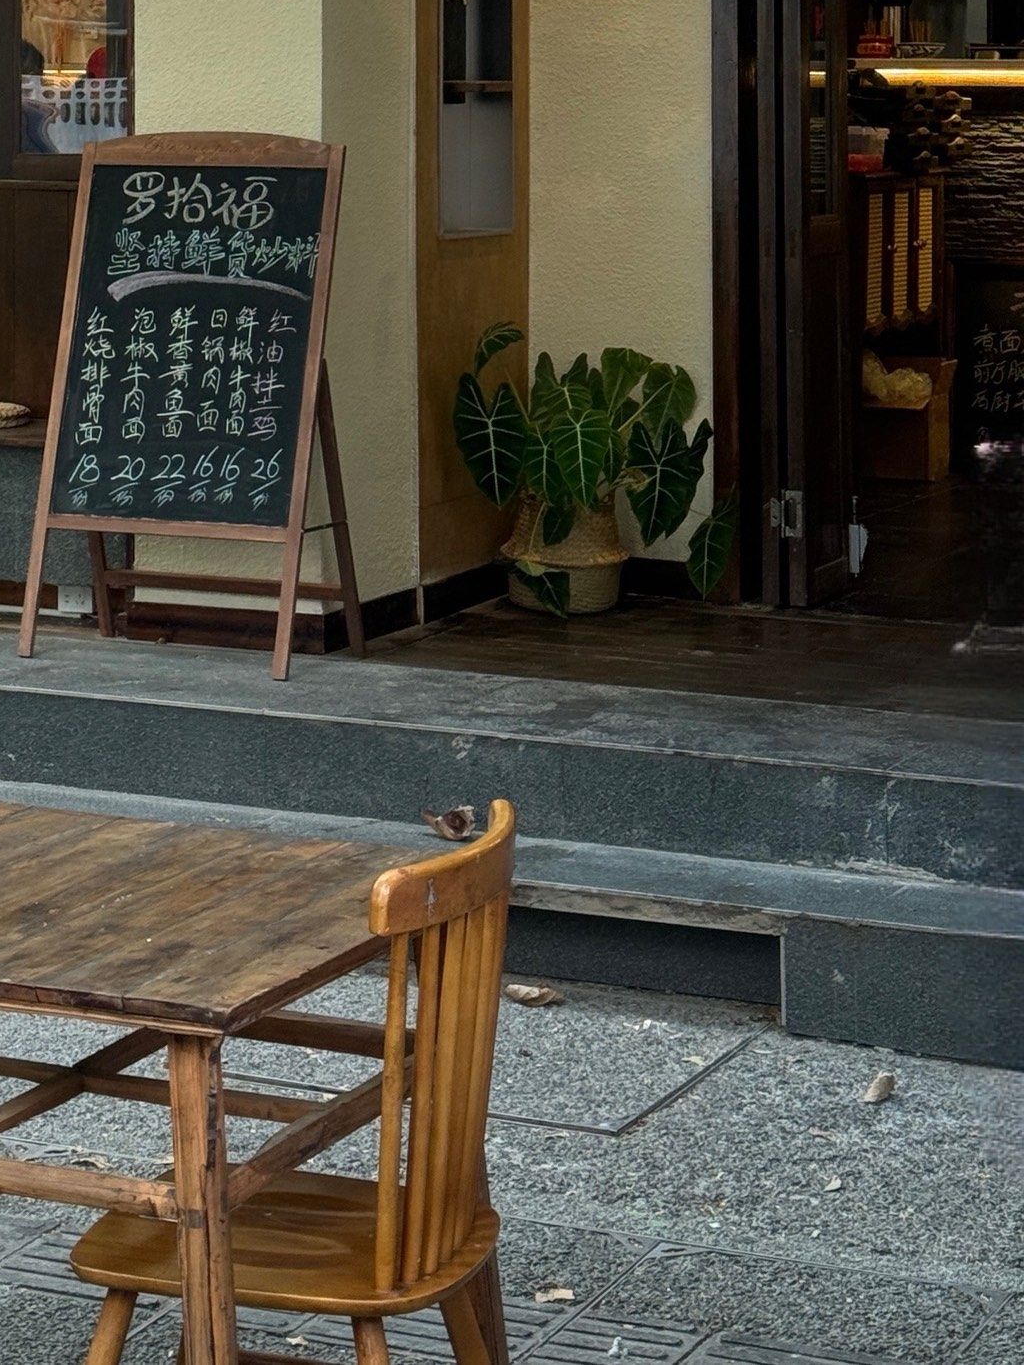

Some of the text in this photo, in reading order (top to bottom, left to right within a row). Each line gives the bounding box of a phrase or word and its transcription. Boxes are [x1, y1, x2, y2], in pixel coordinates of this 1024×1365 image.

[123, 171, 278, 230] 罗拾福
[973, 323, 1024, 355] 煮面
[75, 306, 116, 446] 红烧排骨面
[121, 308, 158, 444] 泡椒牛肉面
[226, 306, 259, 436] 鲜椒牛肉面
[69, 453, 101, 483] 18
[110, 455, 145, 481] 20
[150, 454, 186, 481] 22
[192, 445, 219, 477] 16
[219, 447, 245, 479] 16
[250, 448, 283, 478] 26
